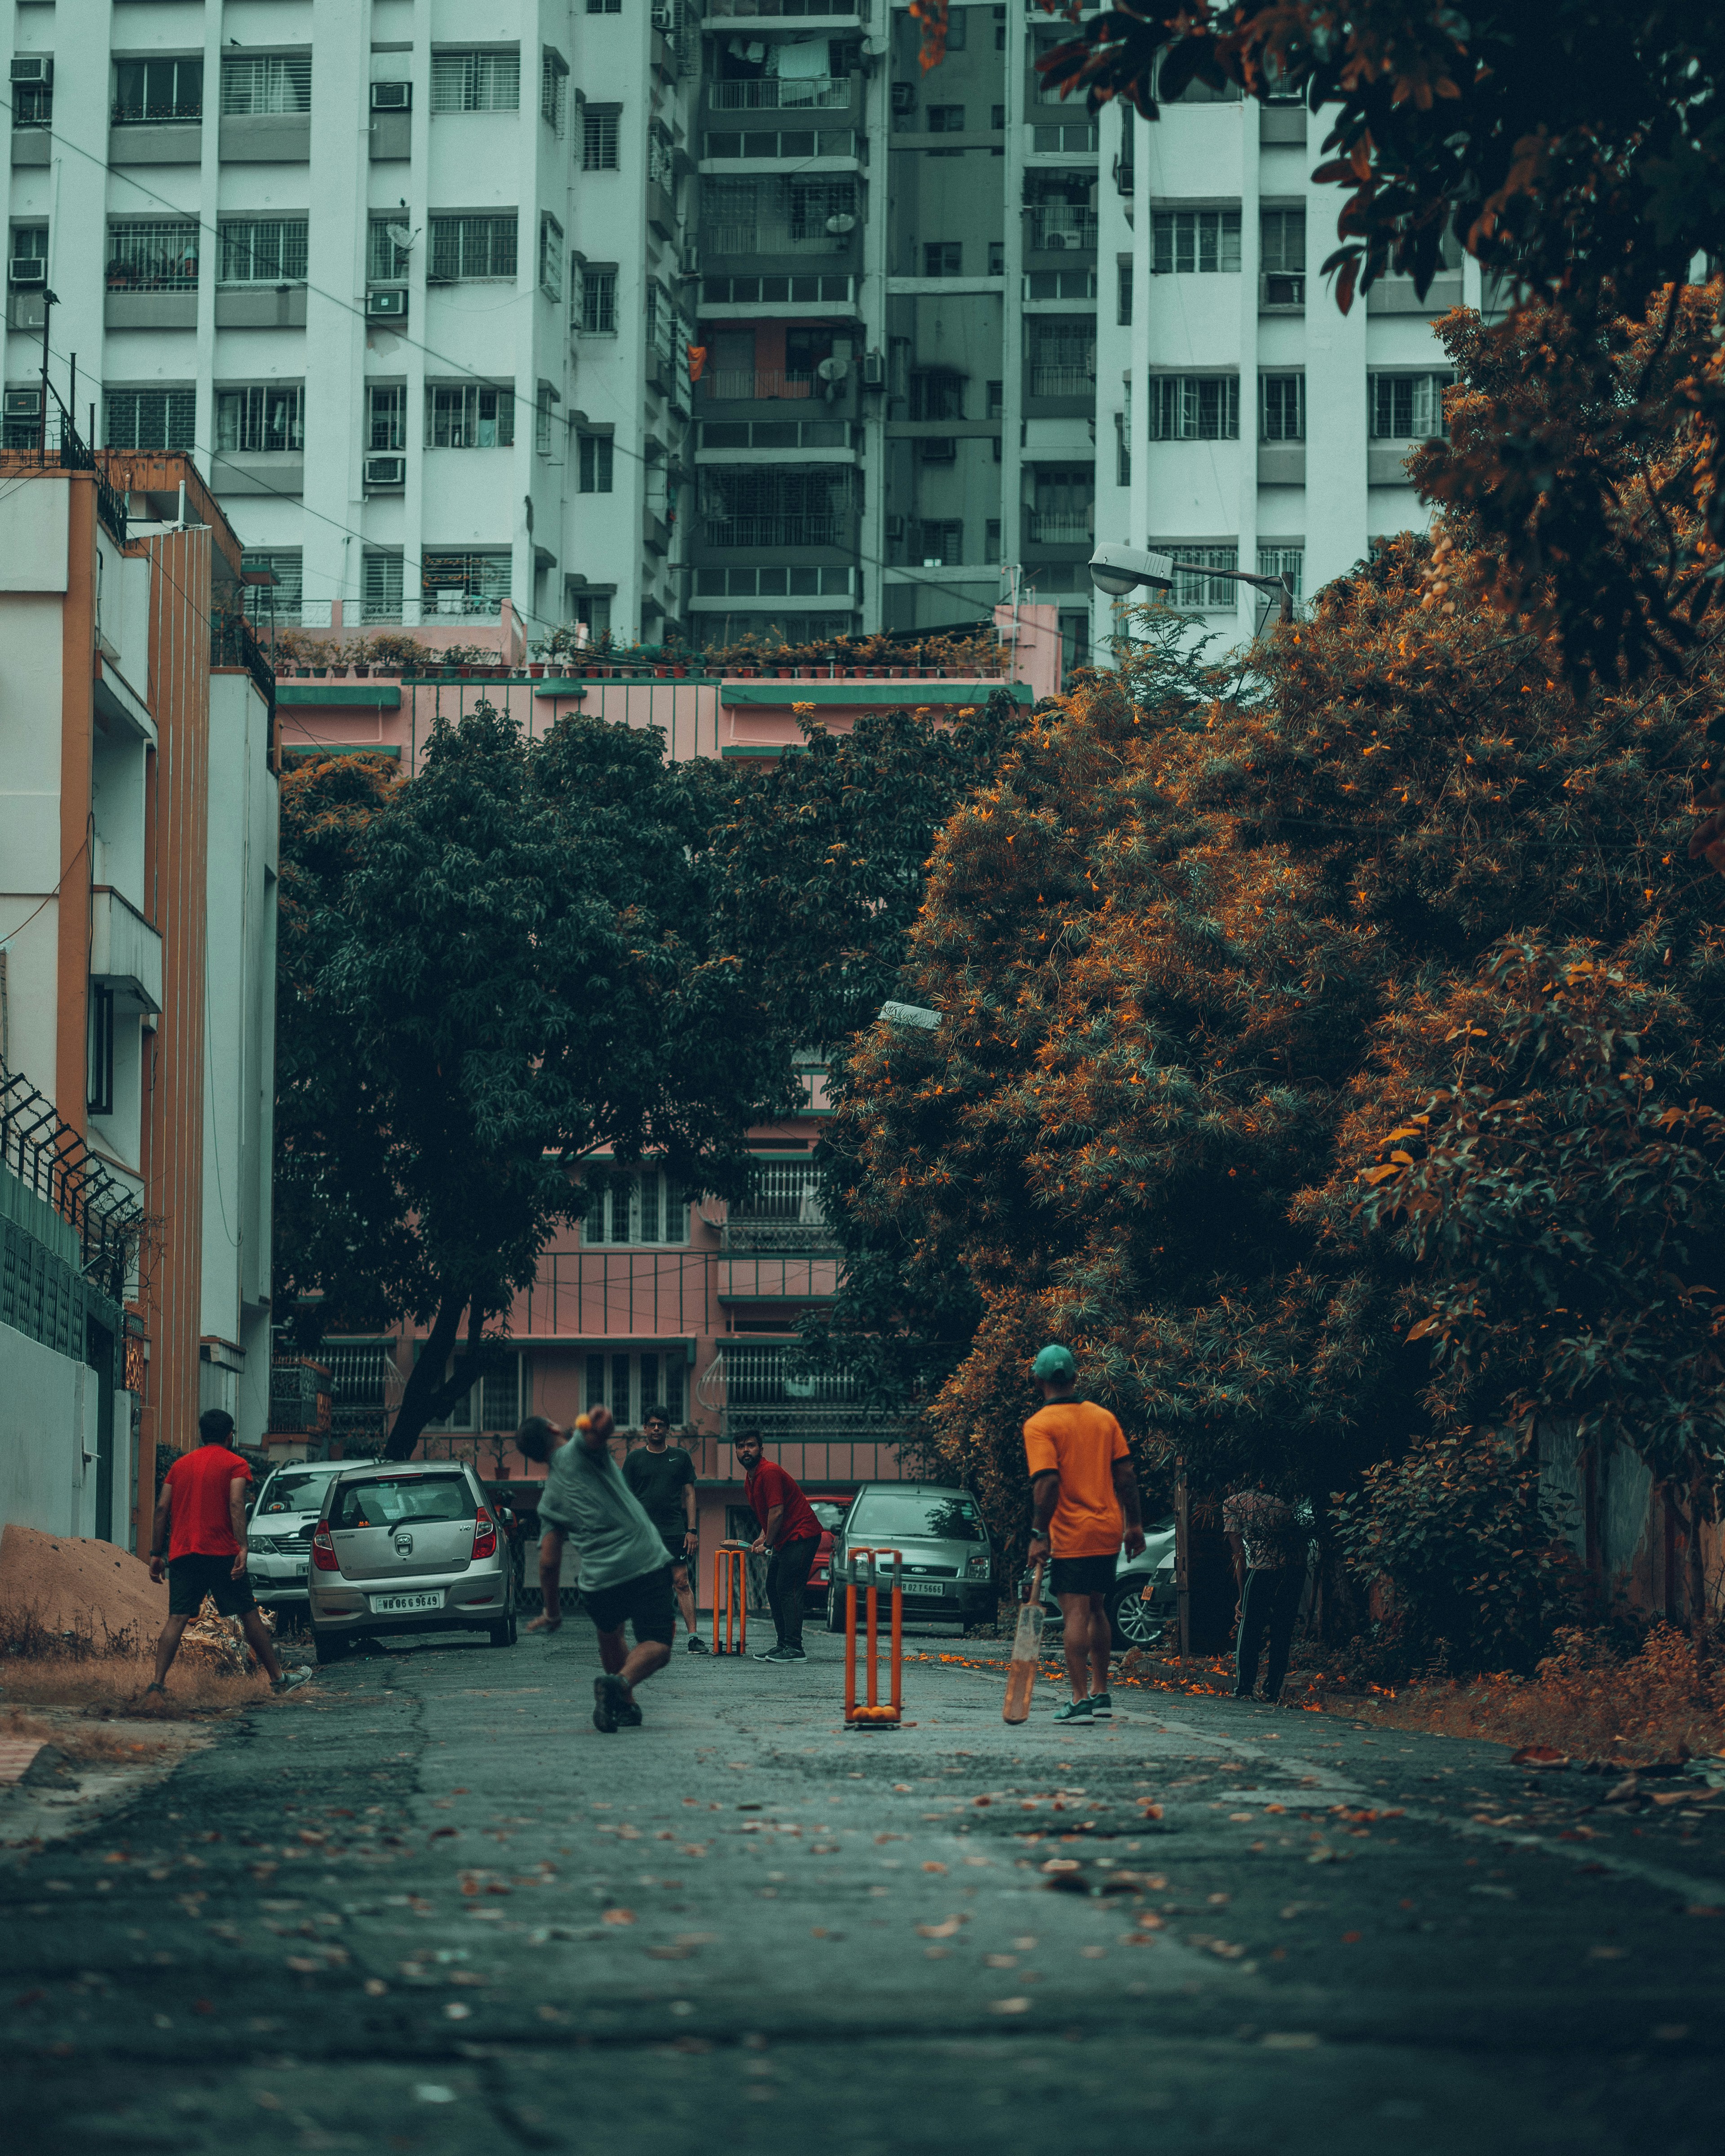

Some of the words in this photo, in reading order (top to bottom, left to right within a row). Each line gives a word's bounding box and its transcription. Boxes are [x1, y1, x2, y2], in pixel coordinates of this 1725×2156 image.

[924, 1585, 942, 1593] 5666
[383, 1599, 394, 1609] WB
[396, 1599, 407, 1608] 06
[416, 1596, 437, 1607] 9649
